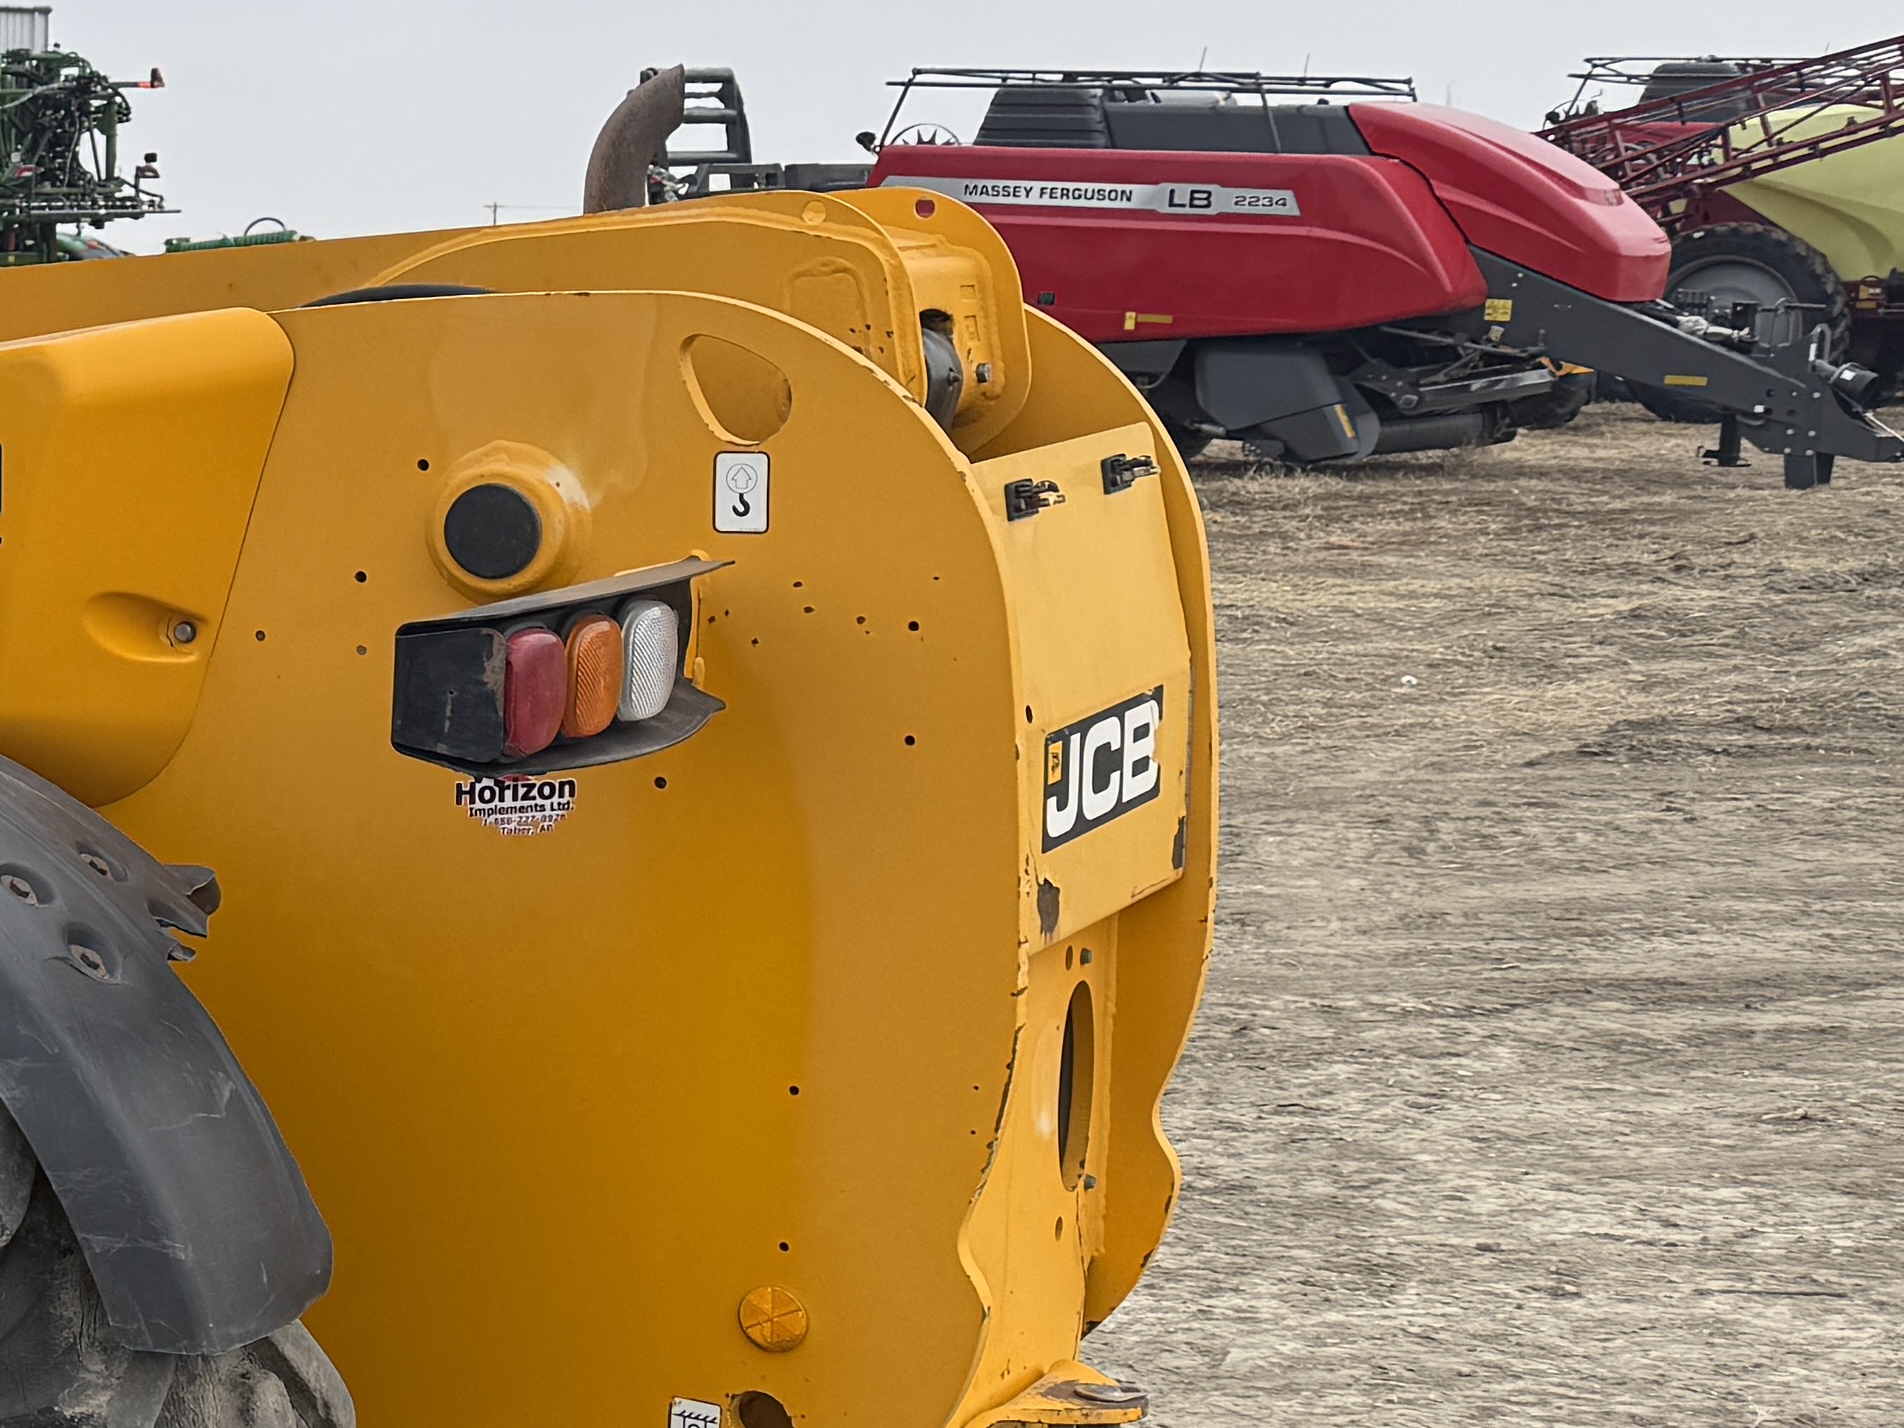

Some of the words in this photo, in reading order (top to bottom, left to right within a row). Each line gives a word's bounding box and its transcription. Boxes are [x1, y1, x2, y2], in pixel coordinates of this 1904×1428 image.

[964, 183, 1033, 198] MASSEY
[1039, 186, 1132, 202] FERGUSON
[1168, 188, 1212, 209] LB
[1233, 195, 1288, 208] 2234
[1046, 699, 1160, 838] JCB
[455, 779, 576, 806] Horizon
[469, 802, 546, 818] Implements
[550, 800, 574, 812] Ltd.
